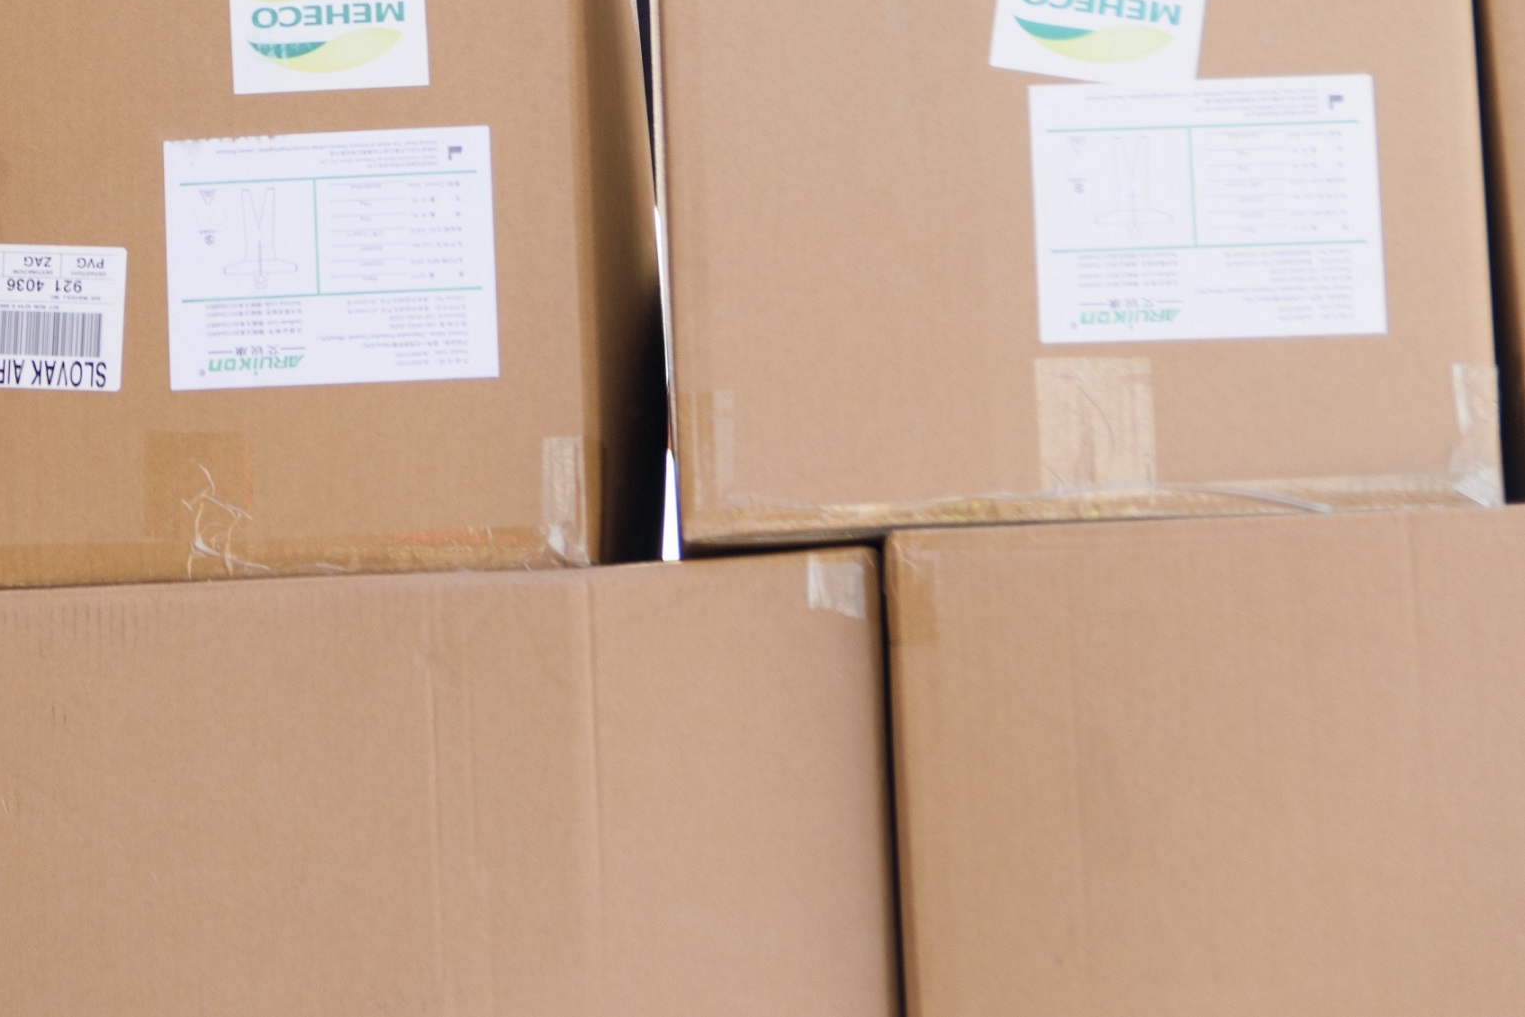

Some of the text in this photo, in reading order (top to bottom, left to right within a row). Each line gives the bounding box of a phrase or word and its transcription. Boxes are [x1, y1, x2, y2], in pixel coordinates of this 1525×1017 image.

[251, 1, 405, 30] MEHECO
[23, 255, 52, 268] ZAG
[76, 257, 104, 269] PVG
[7, 278, 45, 293] 4036
[55, 279, 82, 294] 921
[31, 360, 107, 388] SLOVAK
